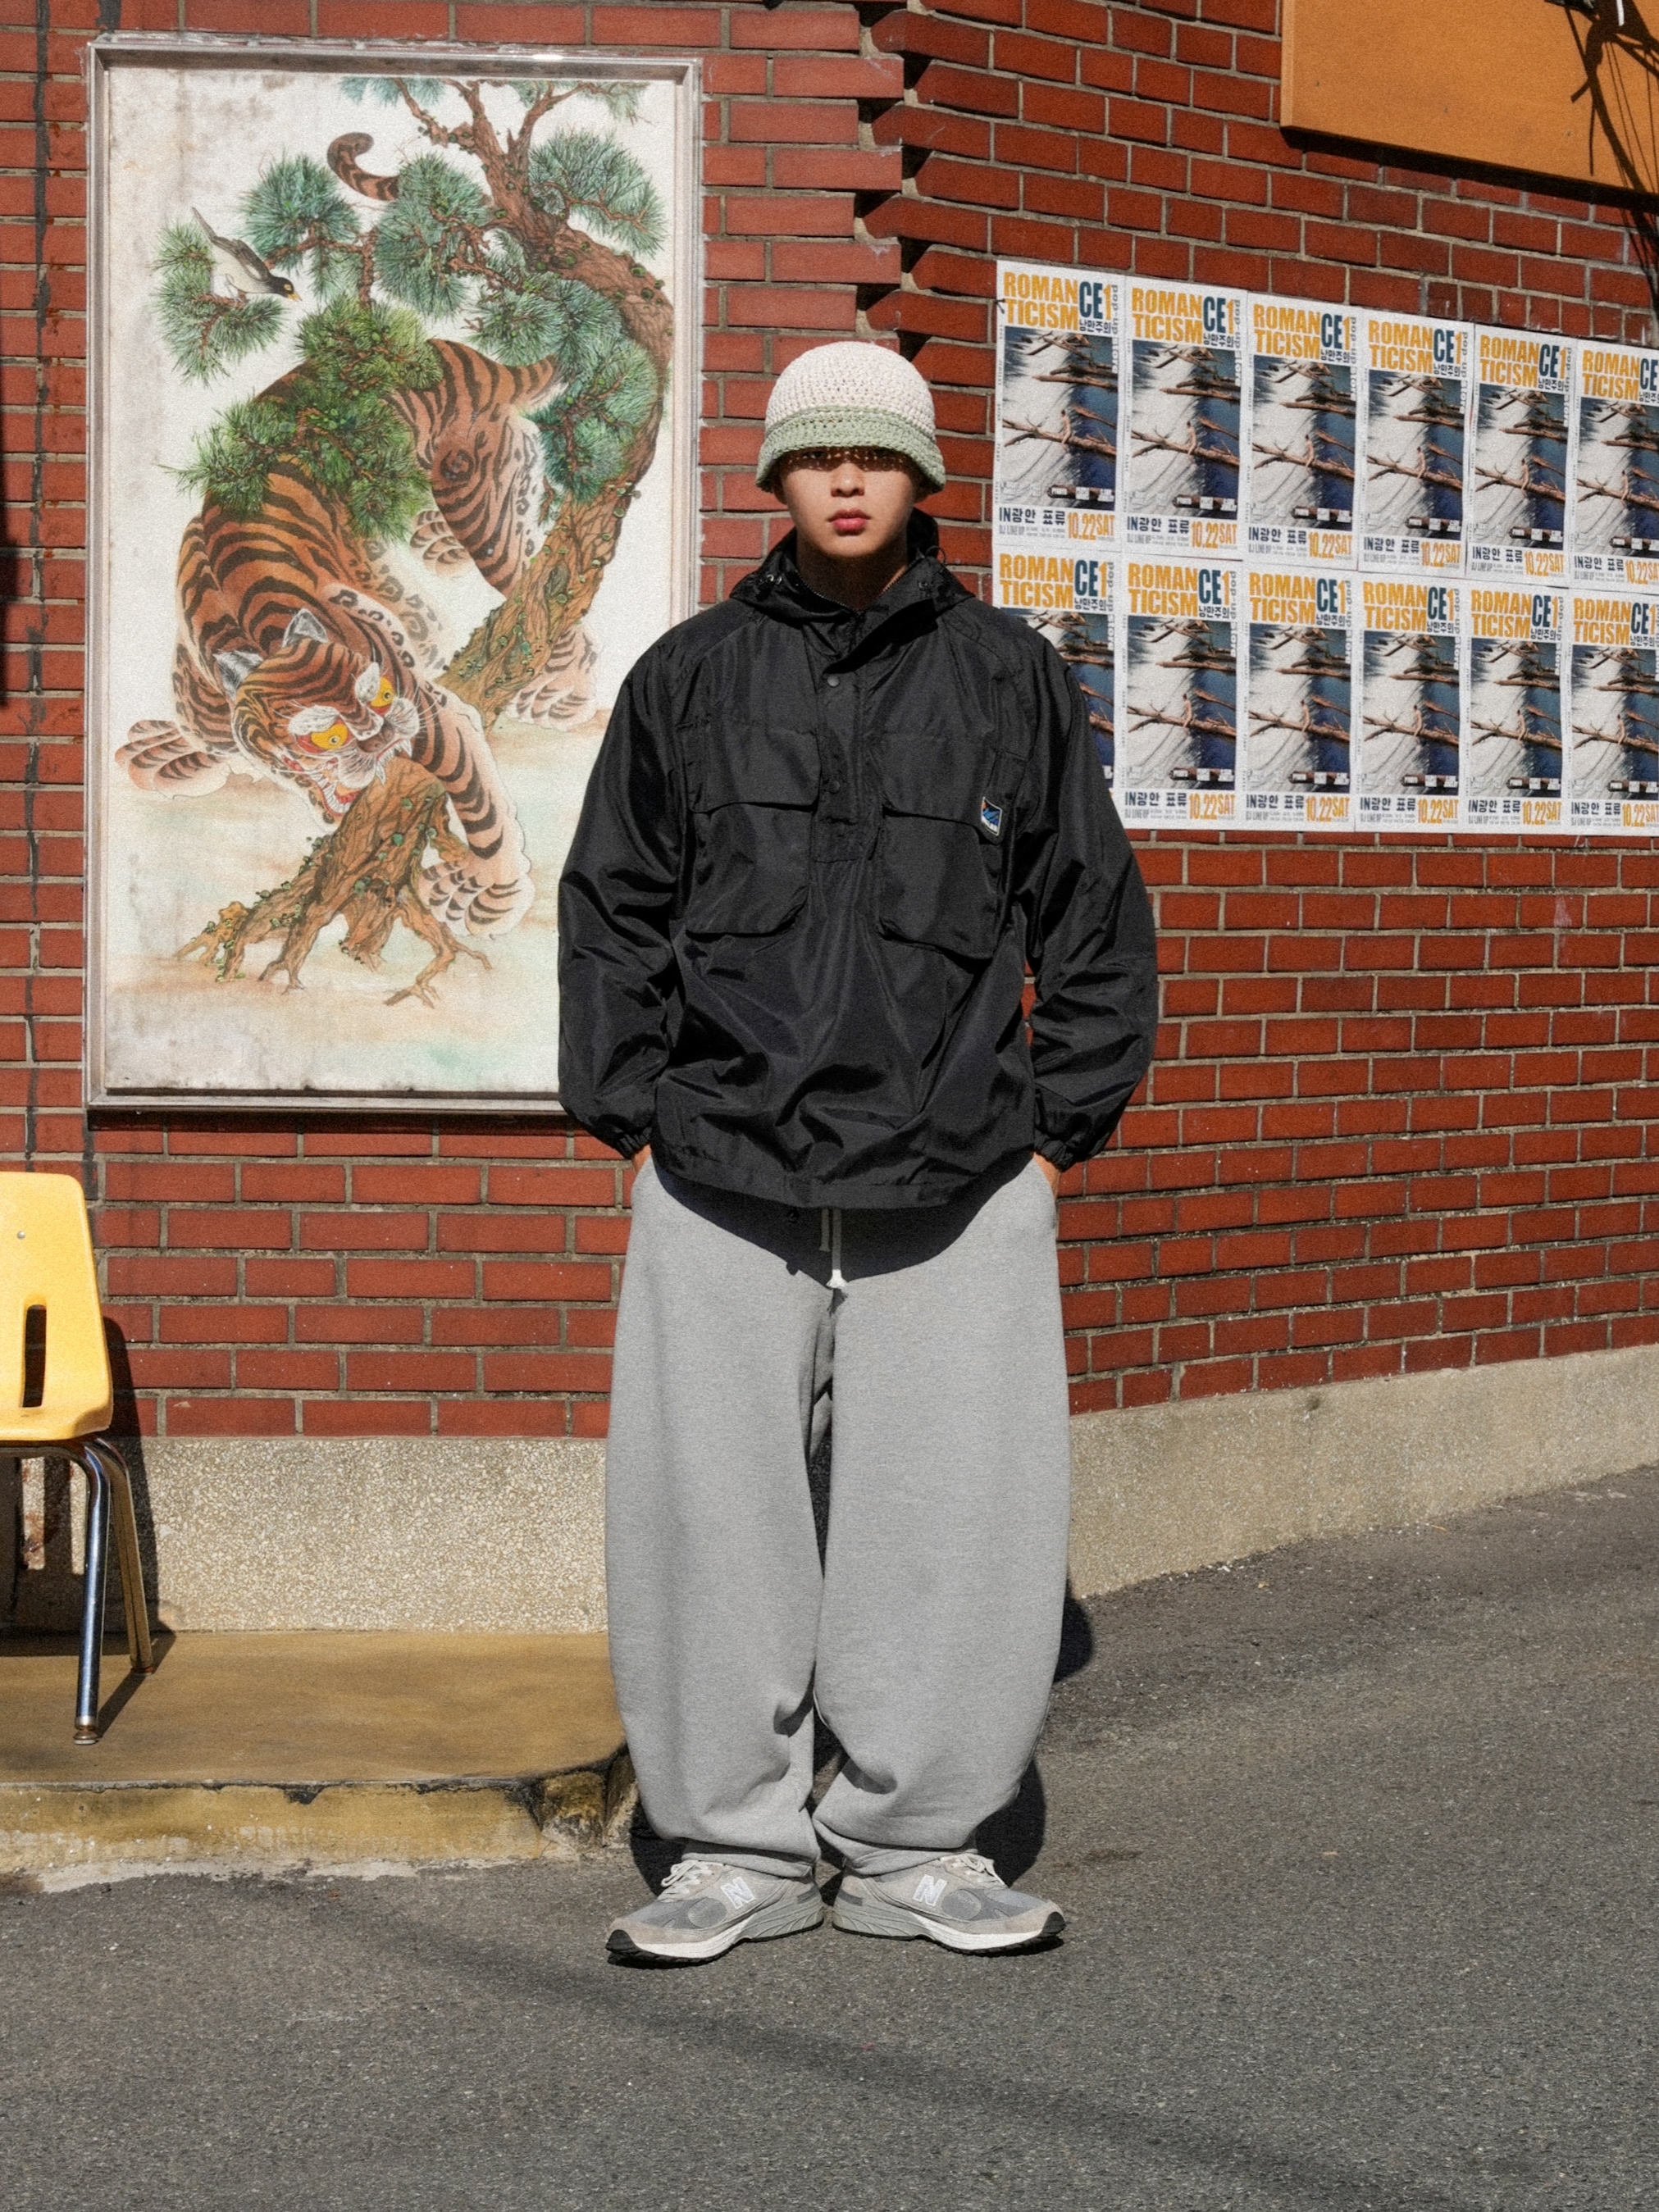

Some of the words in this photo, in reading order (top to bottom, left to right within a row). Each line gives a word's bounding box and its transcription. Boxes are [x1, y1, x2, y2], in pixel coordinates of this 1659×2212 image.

[1004, 272, 1078, 304] ROMAN
[1004, 299, 1078, 330] TICISM
[1133, 288, 1203, 319] ROMAN
[1079, 319, 1111, 335] 낭만주의
[1133, 314, 1202, 344] TICISM
[1254, 304, 1321, 335] ROMAN
[1203, 333, 1233, 348] 낭만주의
[1254, 330, 1320, 360] TICISM
[1370, 319, 1433, 349] ROMAN
[1321, 349, 1350, 363] 낭만주의
[1370, 344, 1433, 374] TICISM
[1480, 335, 1540, 364] ROMAN
[1433, 363, 1461, 377] 낭만주의
[1480, 359, 1539, 388] TICISM
[1582, 350, 1639, 378] ROMAN
[1538, 378, 1564, 392] 낭만주의
[1582, 373, 1638, 401] TICISM
[1042, 511, 1065, 526] 표류
[1169, 520, 1190, 535] 표류
[1288, 530, 1307, 544] 표류
[1400, 540, 1420, 554] 표류
[999, 553, 1074, 583] ROMAN
[1506, 550, 1524, 564] 표류
[1607, 559, 1624, 573] 표류
[1128, 564, 1198, 592] ROMAN
[1250, 573, 1316, 600] ROMAN
[999, 580, 1073, 609] TICISM
[1075, 598, 1106, 612] 낭만주의
[1128, 590, 1197, 617] TICISM
[1365, 582, 1427, 608] ROMAN
[1471, 590, 1530, 616] ROMAN
[1199, 606, 1229, 619] 낭만주의
[1250, 599, 1315, 625] TICISM
[1316, 614, 1345, 627] 낭만주의
[1365, 607, 1426, 631] TICISM
[1575, 599, 1630, 622] ROMAN
[1427, 621, 1454, 634] 낭만주의
[1471, 614, 1530, 639] TICISM
[1531, 628, 1556, 640] 낭만주의
[1575, 621, 1630, 644] TICISM
[1631, 635, 1655, 647] 낭만주의
[1165, 794, 1187, 808] 표류
[1284, 796, 1305, 810] 표류
[1397, 799, 1416, 812] 표류
[1503, 801, 1520, 813] 표류
[1604, 803, 1620, 816] 표류
[720, 1877, 755, 1909] N
[912, 1874, 947, 1906] N
